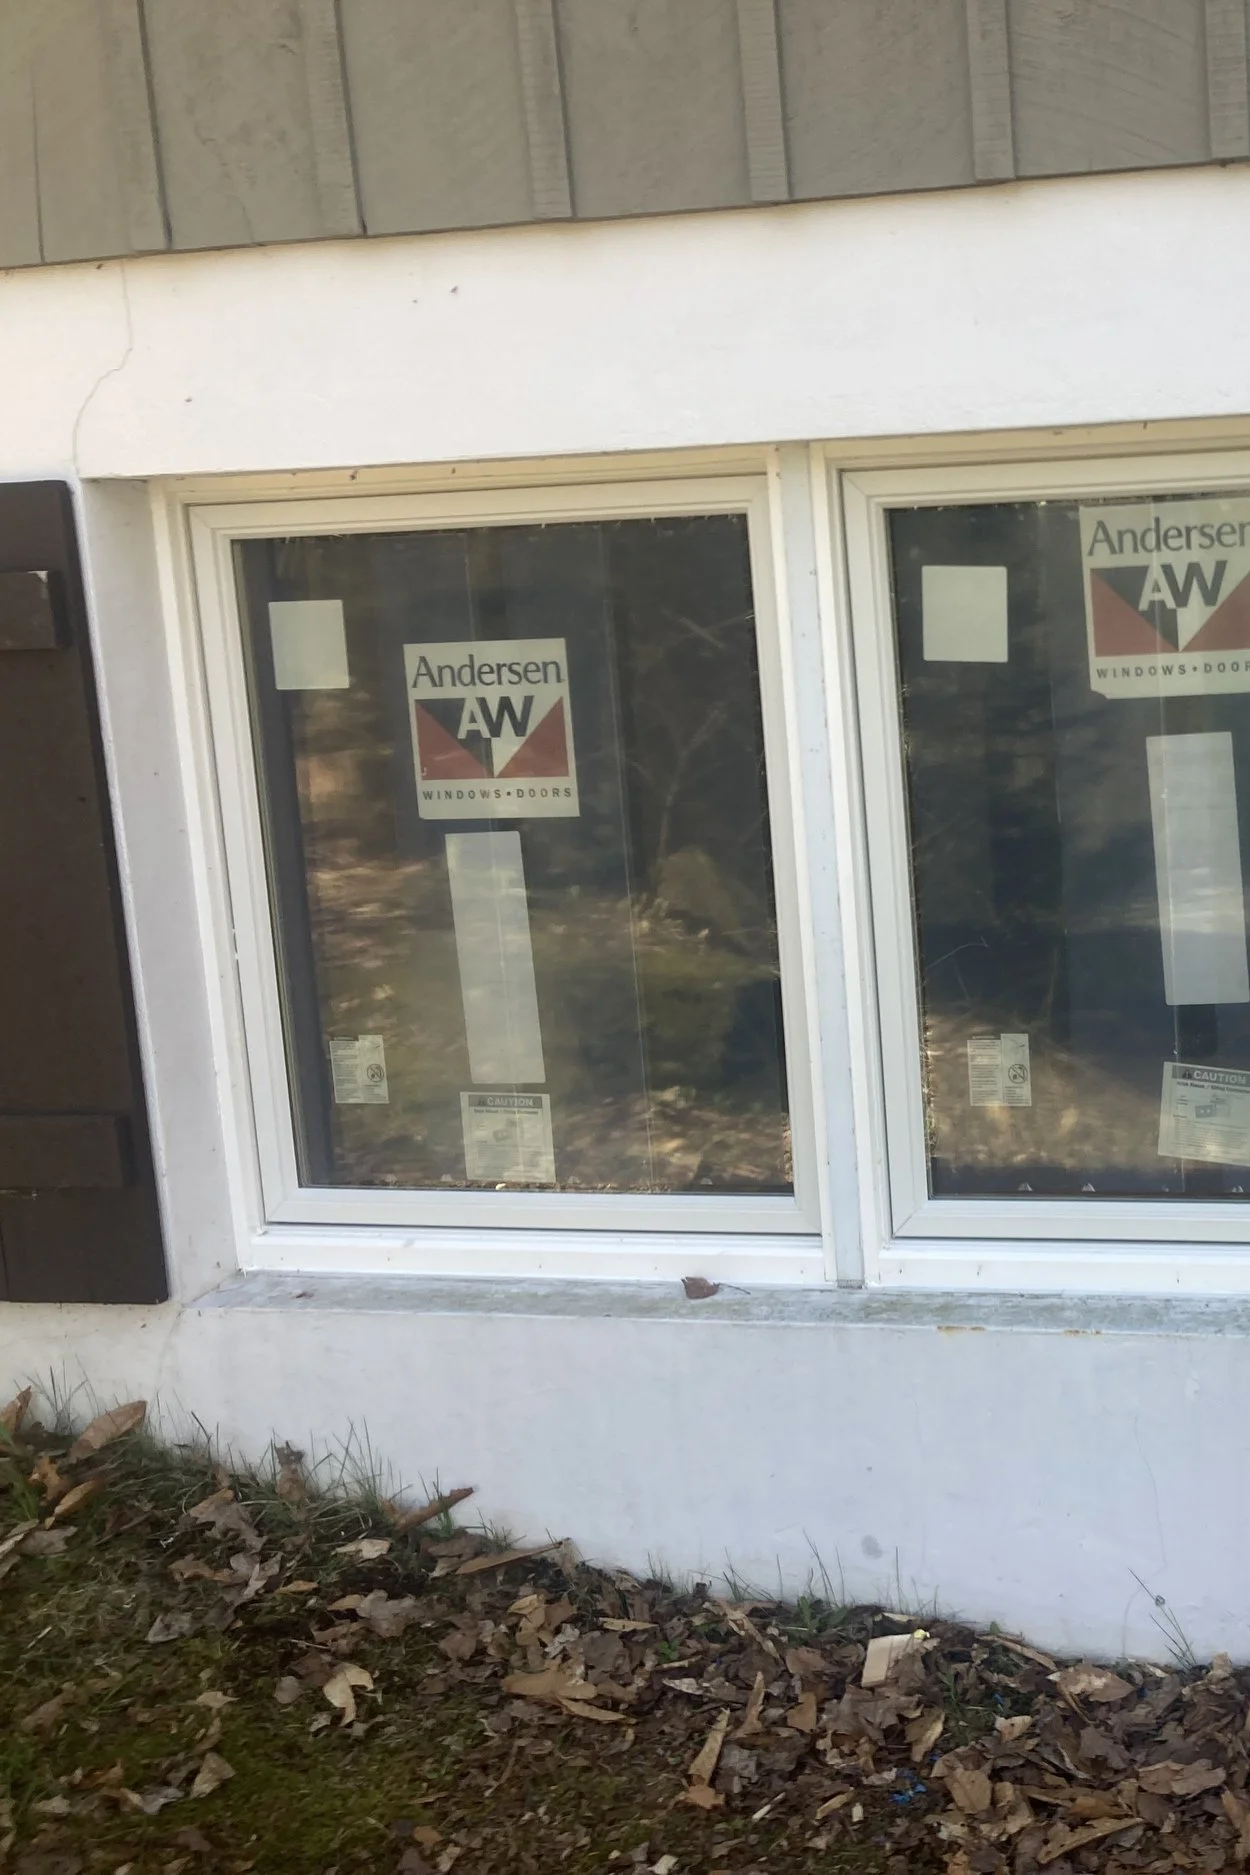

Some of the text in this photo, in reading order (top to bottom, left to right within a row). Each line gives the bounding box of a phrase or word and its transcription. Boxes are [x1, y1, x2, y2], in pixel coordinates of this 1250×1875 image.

[1138, 560, 1228, 612] AW
[411, 653, 563, 689] Andersen
[1096, 663, 1187, 679] WINDOWS
[457, 695, 535, 739] AW
[422, 787, 572, 801] WINDOWS DOORS
[1193, 1070, 1248, 1085] CAUTION
[487, 1096, 534, 1108] CAUTION
